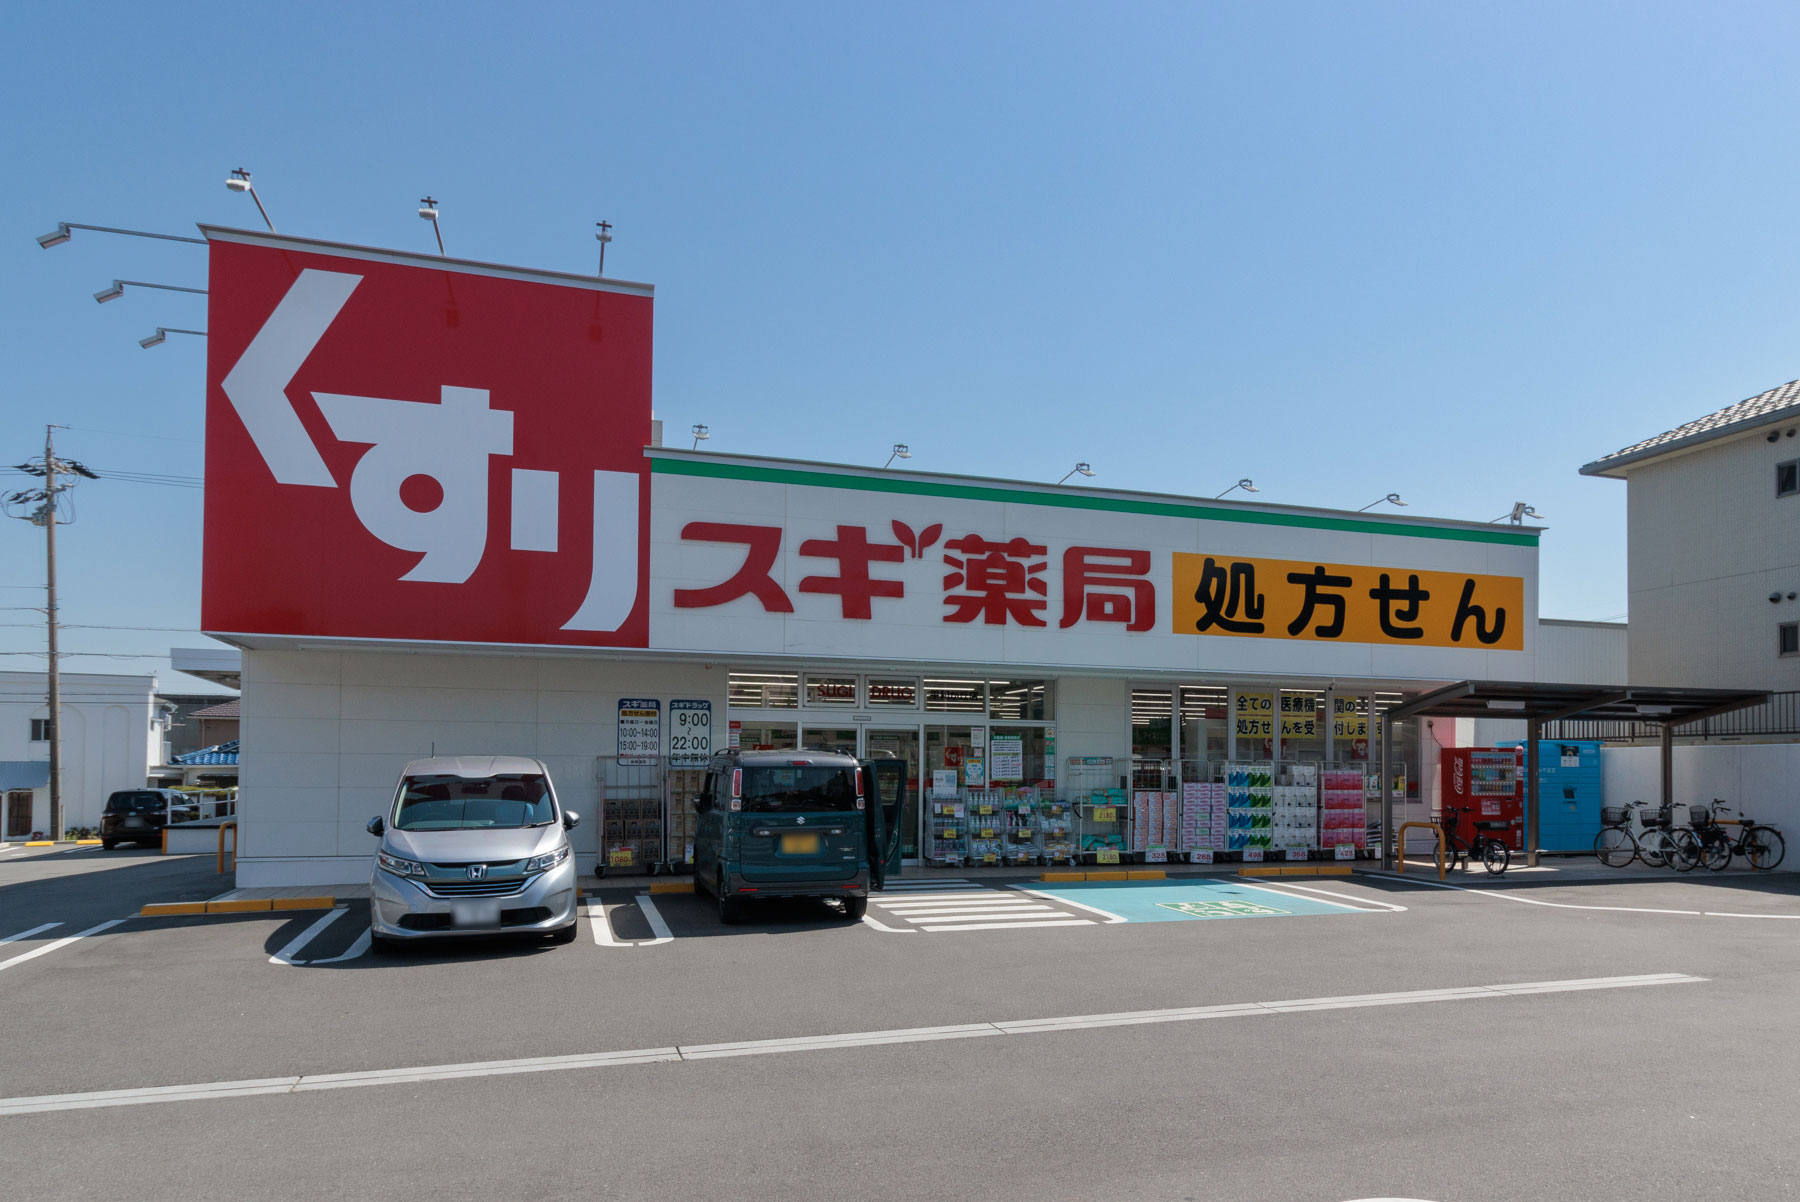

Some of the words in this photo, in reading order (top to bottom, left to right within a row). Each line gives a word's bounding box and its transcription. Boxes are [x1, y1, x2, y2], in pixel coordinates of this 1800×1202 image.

[221, 268, 640, 632] くすり
[674, 520, 1156, 632] スギ薬局
[1194, 557, 1506, 645] 処方せん
[817, 684, 852, 698] SUGI
[871, 686, 912, 699] DRUG
[1236, 695, 1272, 711] 全ての
[1280, 696, 1315, 713] 医療機
[680, 713, 709, 727] 9:00
[1236, 719, 1272, 735] 処方せ
[1280, 720, 1315, 736] んを受
[671, 736, 709, 750] 22:00
